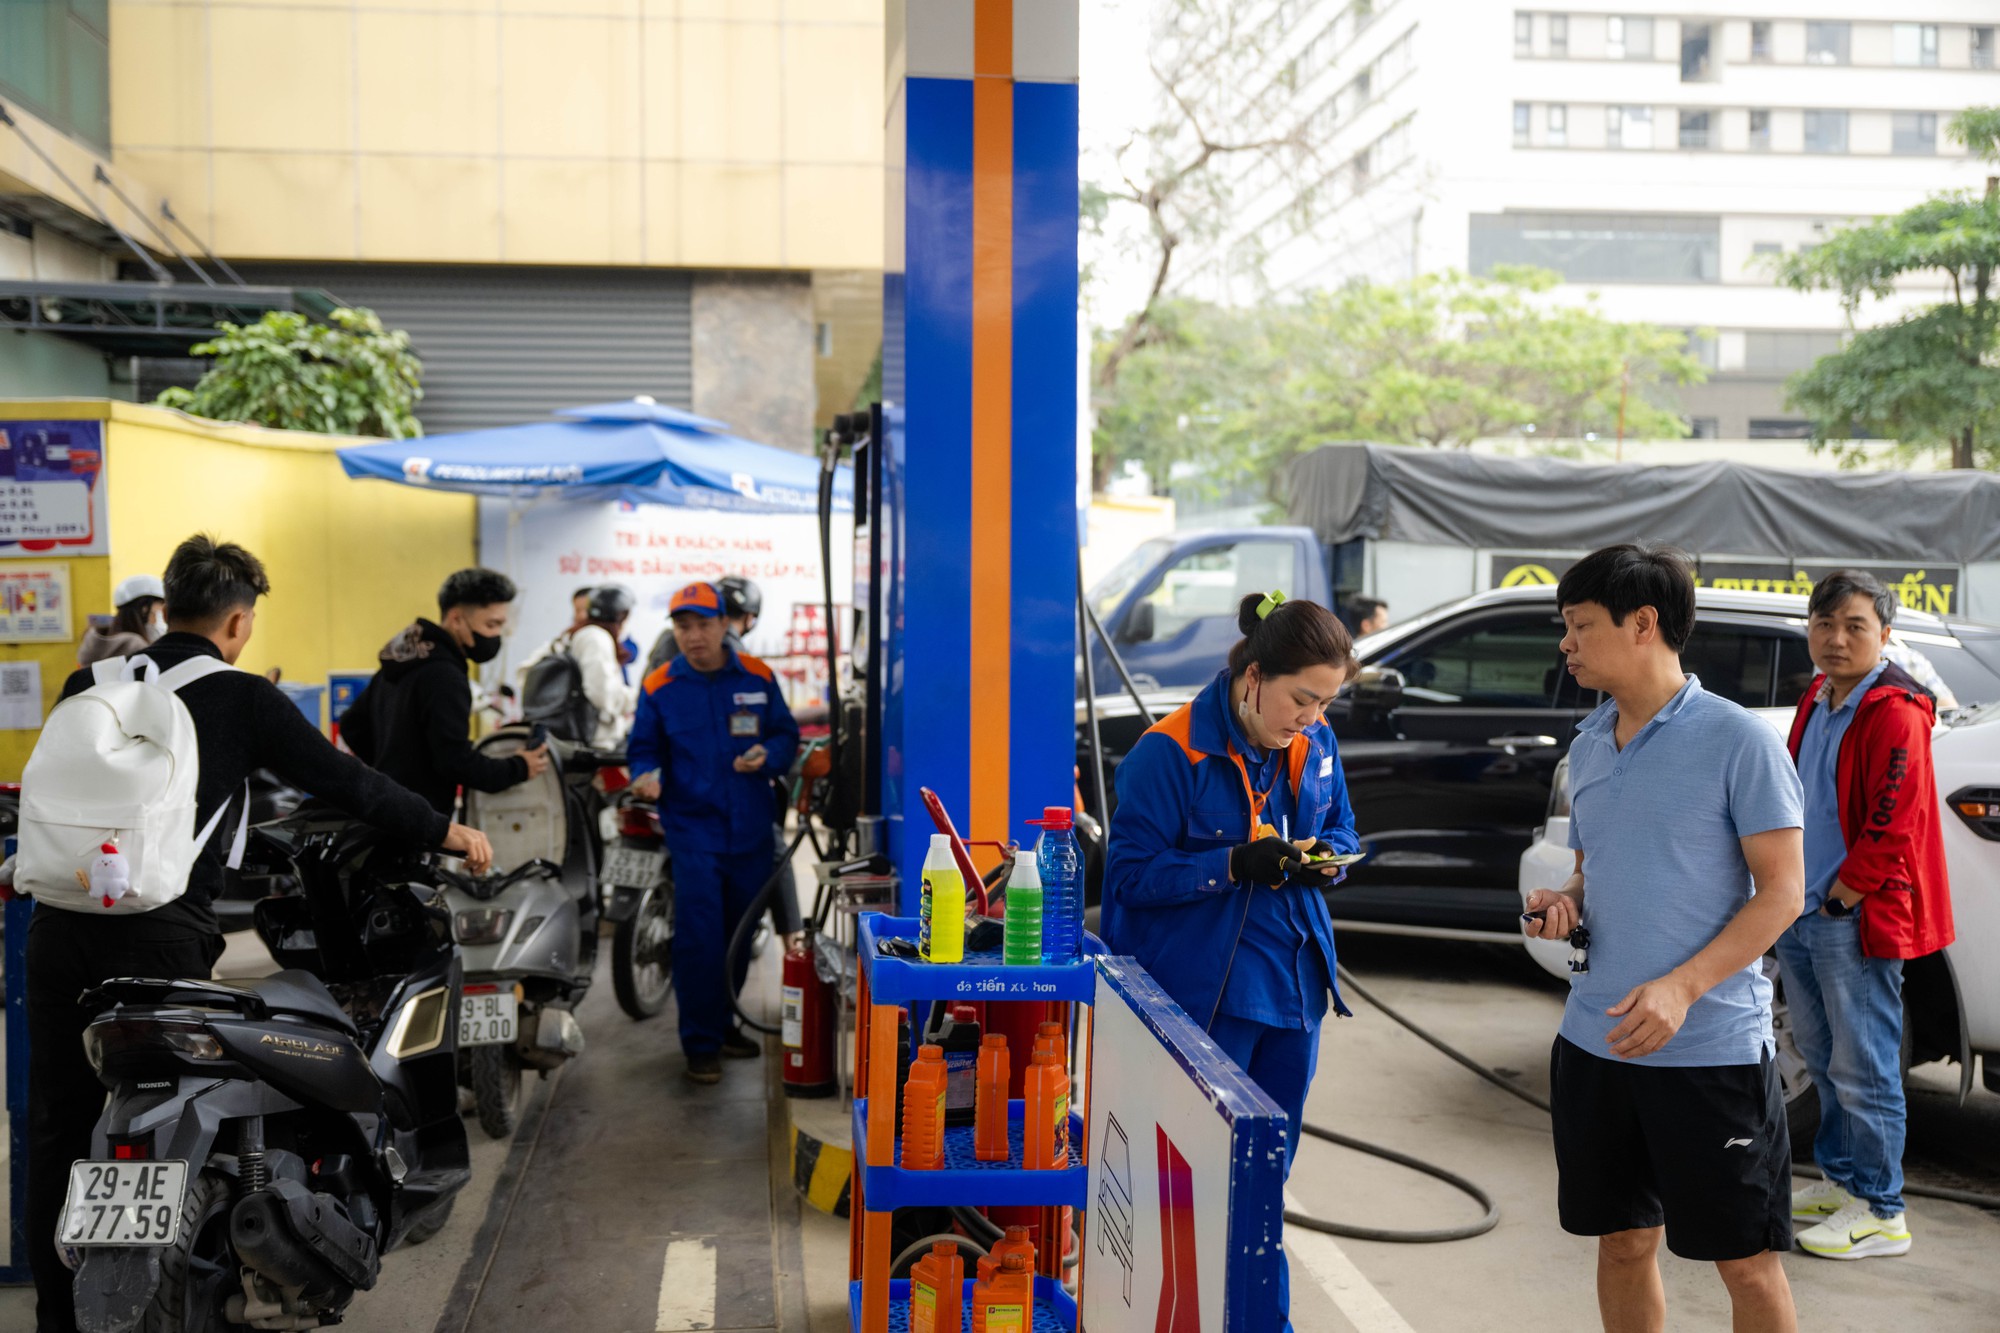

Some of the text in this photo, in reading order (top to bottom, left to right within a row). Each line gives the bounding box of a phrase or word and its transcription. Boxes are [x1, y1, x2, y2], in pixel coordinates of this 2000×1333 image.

[460, 996, 505, 1019] 9-BL
[461, 1019, 511, 1042] 82.00
[137, 1081, 171, 1089] HONDA
[84, 1166, 169, 1200] 29-AE
